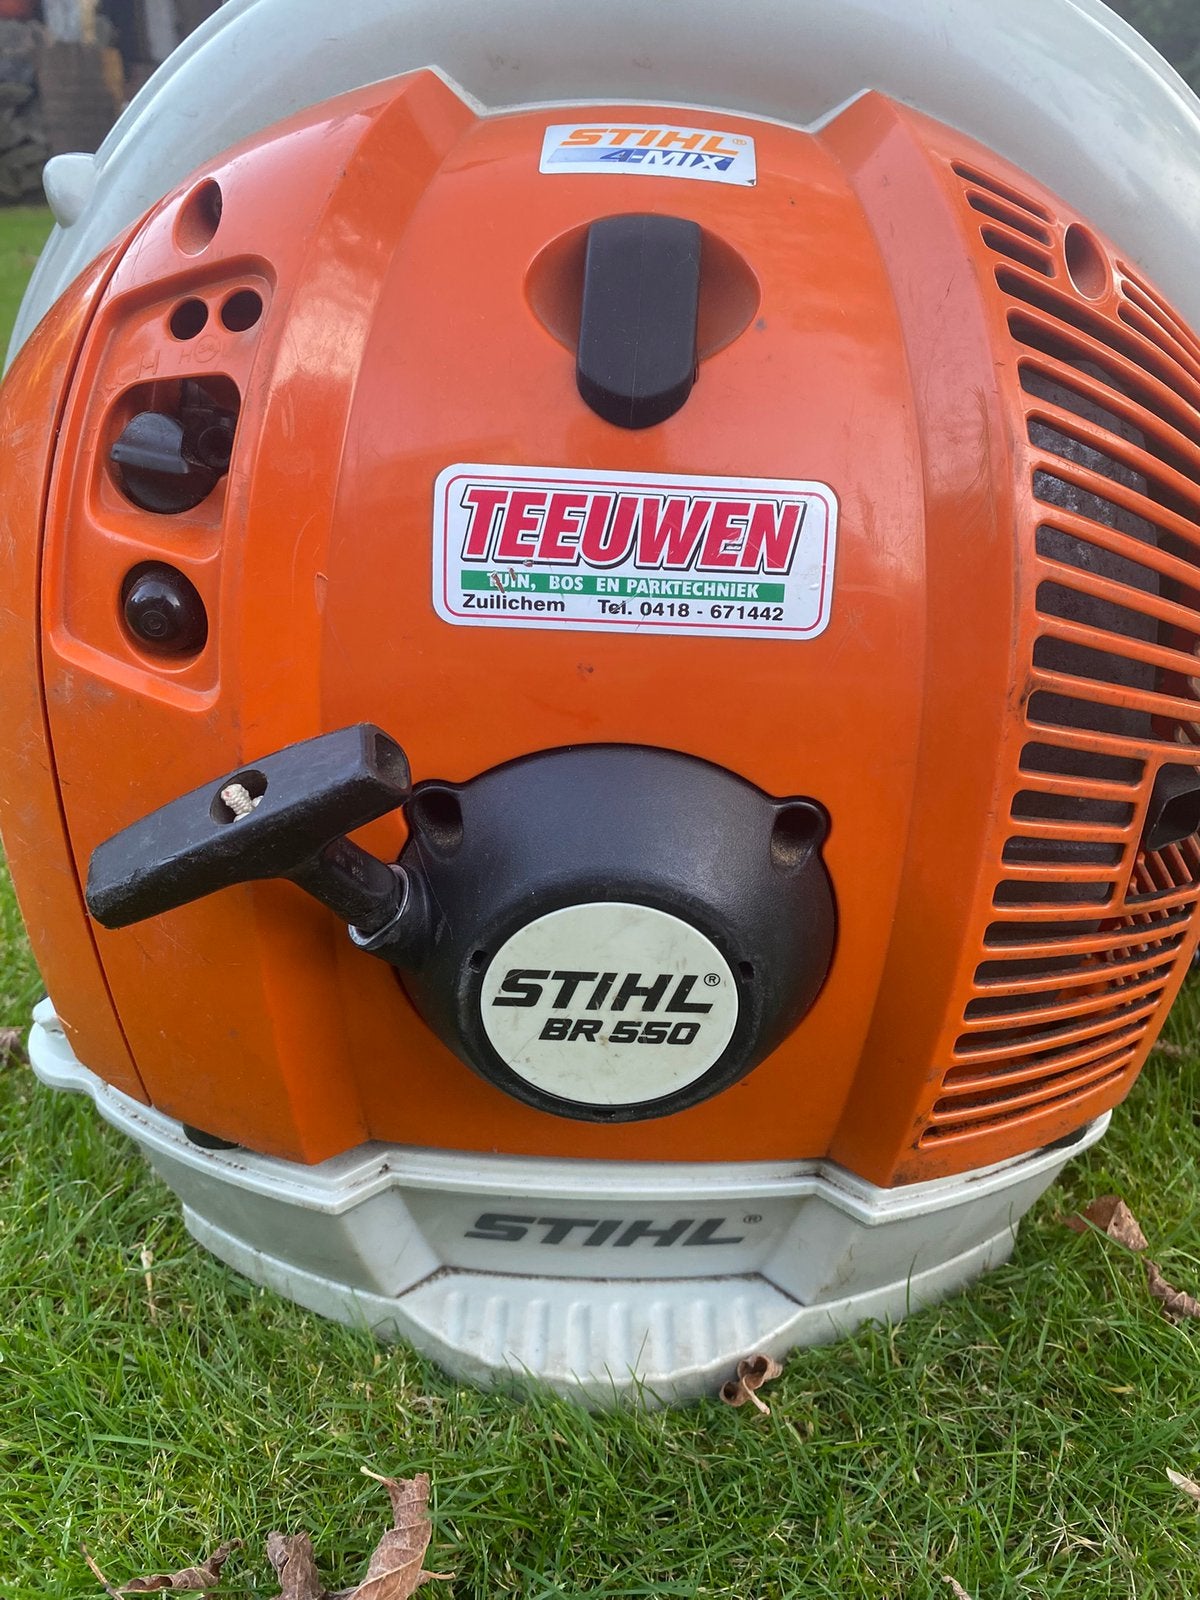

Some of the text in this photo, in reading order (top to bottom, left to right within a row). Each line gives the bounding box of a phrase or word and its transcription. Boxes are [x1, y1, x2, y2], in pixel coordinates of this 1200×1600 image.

[599, 149, 728, 172] 4-MIX
[460, 484, 806, 575] TEEUWEN
[549, 575, 584, 591] BOS
[596, 577, 620, 593] EN
[626, 578, 760, 599] PARKTECHNIEK
[462, 593, 566, 612] Zuilichem
[597, 599, 633, 615] Tel.
[640, 601, 690, 618] 0418
[710, 604, 784, 621] 671442
[538, 1018, 701, 1045] BR 550
